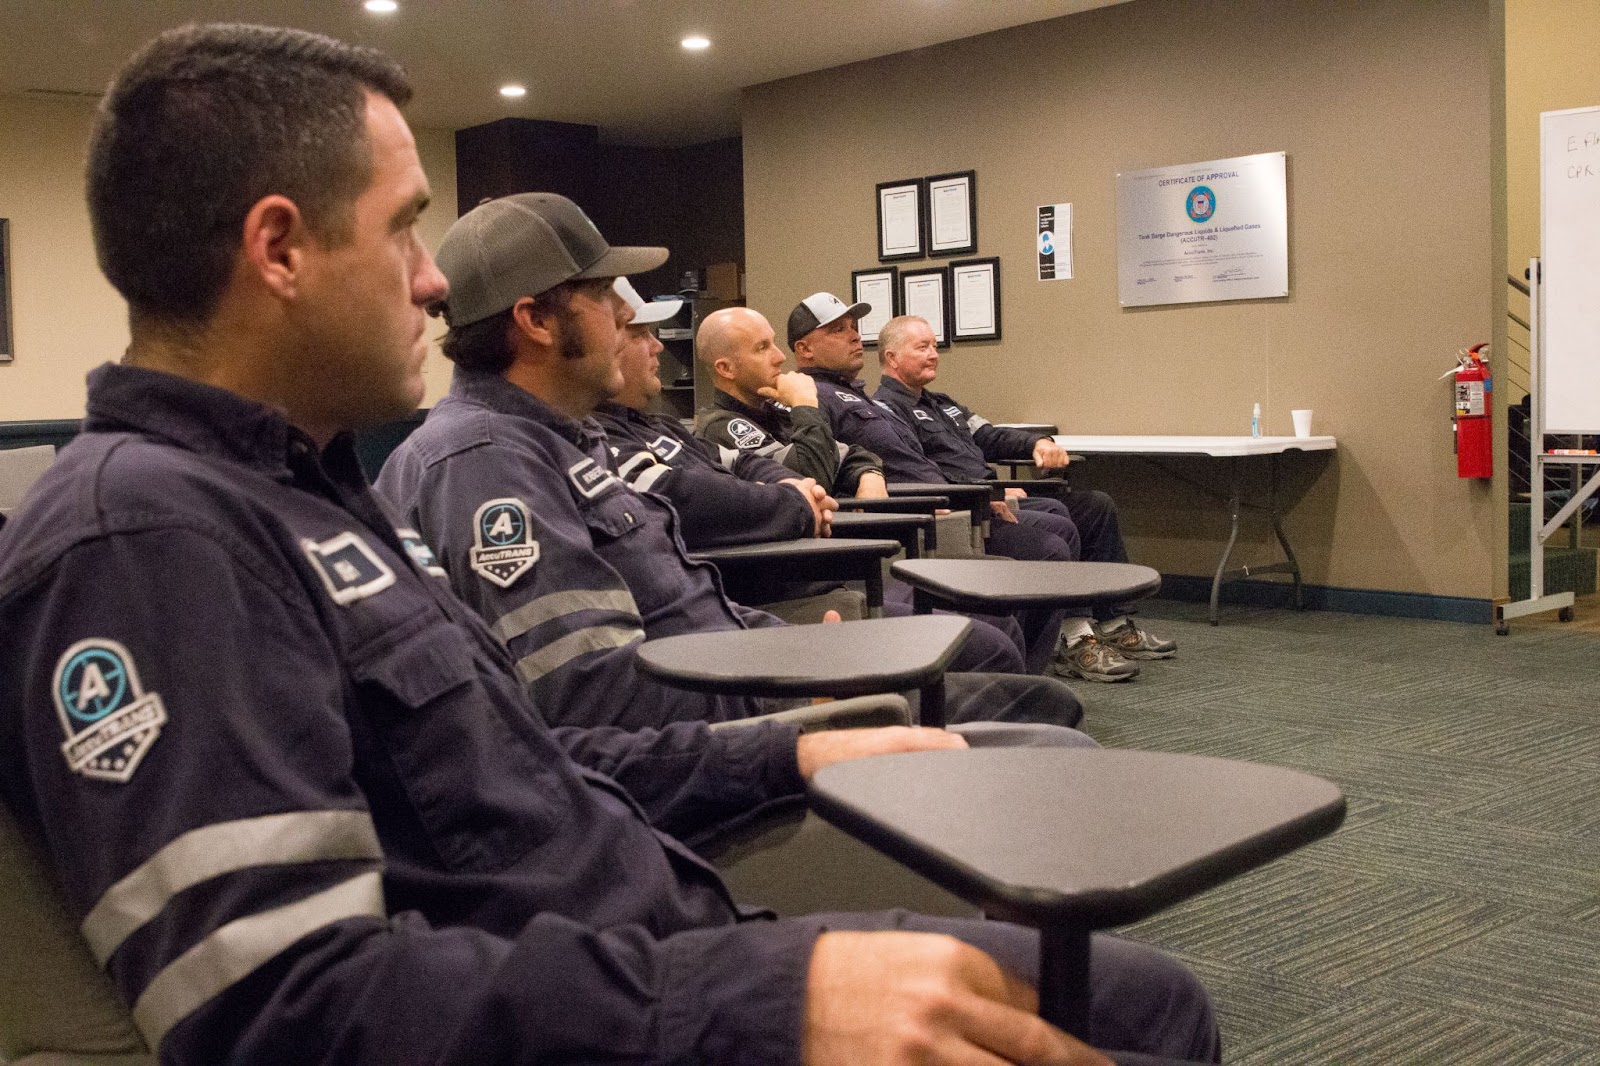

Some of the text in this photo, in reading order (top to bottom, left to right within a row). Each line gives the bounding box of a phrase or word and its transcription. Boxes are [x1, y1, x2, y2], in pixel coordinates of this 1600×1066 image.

[1158, 175, 1196, 187] CERTIFICATE
[1206, 171, 1240, 181] APPROVAL
[1166, 230, 1194, 238] Dangerous
[1194, 227, 1213, 235] Liquids
[488, 511, 514, 536] A
[76, 662, 111, 711] A
